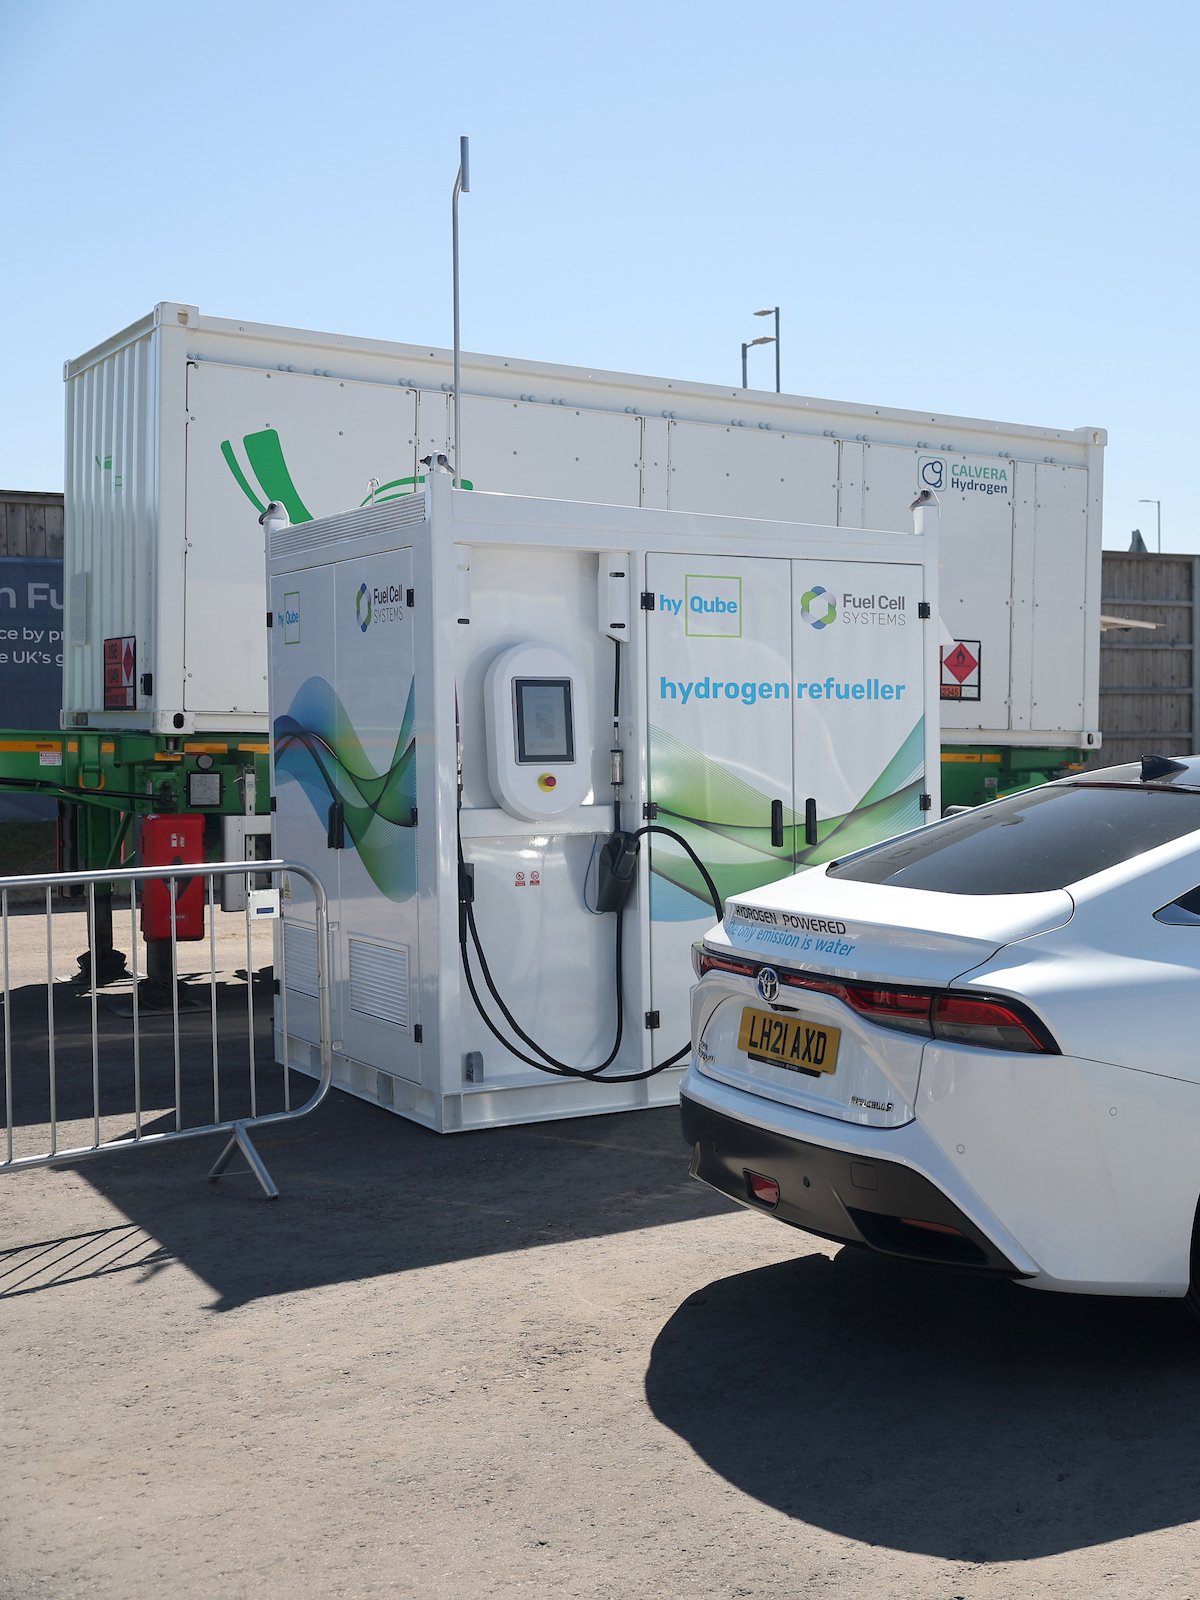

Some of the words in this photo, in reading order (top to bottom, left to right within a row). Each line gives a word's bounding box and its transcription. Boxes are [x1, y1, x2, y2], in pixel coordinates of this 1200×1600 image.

[951, 464, 1008, 481] CALVERA
[951, 477, 1008, 495] Hydrogen
[373, 587, 389, 605] Fuel
[389, 583, 403, 602] Cell
[842, 593, 875, 609] Fuel
[877, 595, 906, 611] Cell
[373, 605, 404, 624] SYSTEMS
[659, 594, 683, 616] hy
[690, 595, 738, 614] Qube
[278, 611, 285, 628] hy
[285, 610, 299, 625] Qube
[842, 611, 906, 626] SYSTEMS
[23, 627, 44, 643] by
[660, 676, 790, 705] hydrogen
[797, 677, 906, 701] refueller
[735, 905, 778, 925] HYDROGEN
[782, 914, 846, 935] POWERED
[737, 923, 757, 943] only
[756, 927, 801, 948] emission
[801, 933, 812, 950] is
[815, 939, 856, 957] water
[748, 1015, 790, 1056] LH21
[789, 1026, 827, 1066] AXD
